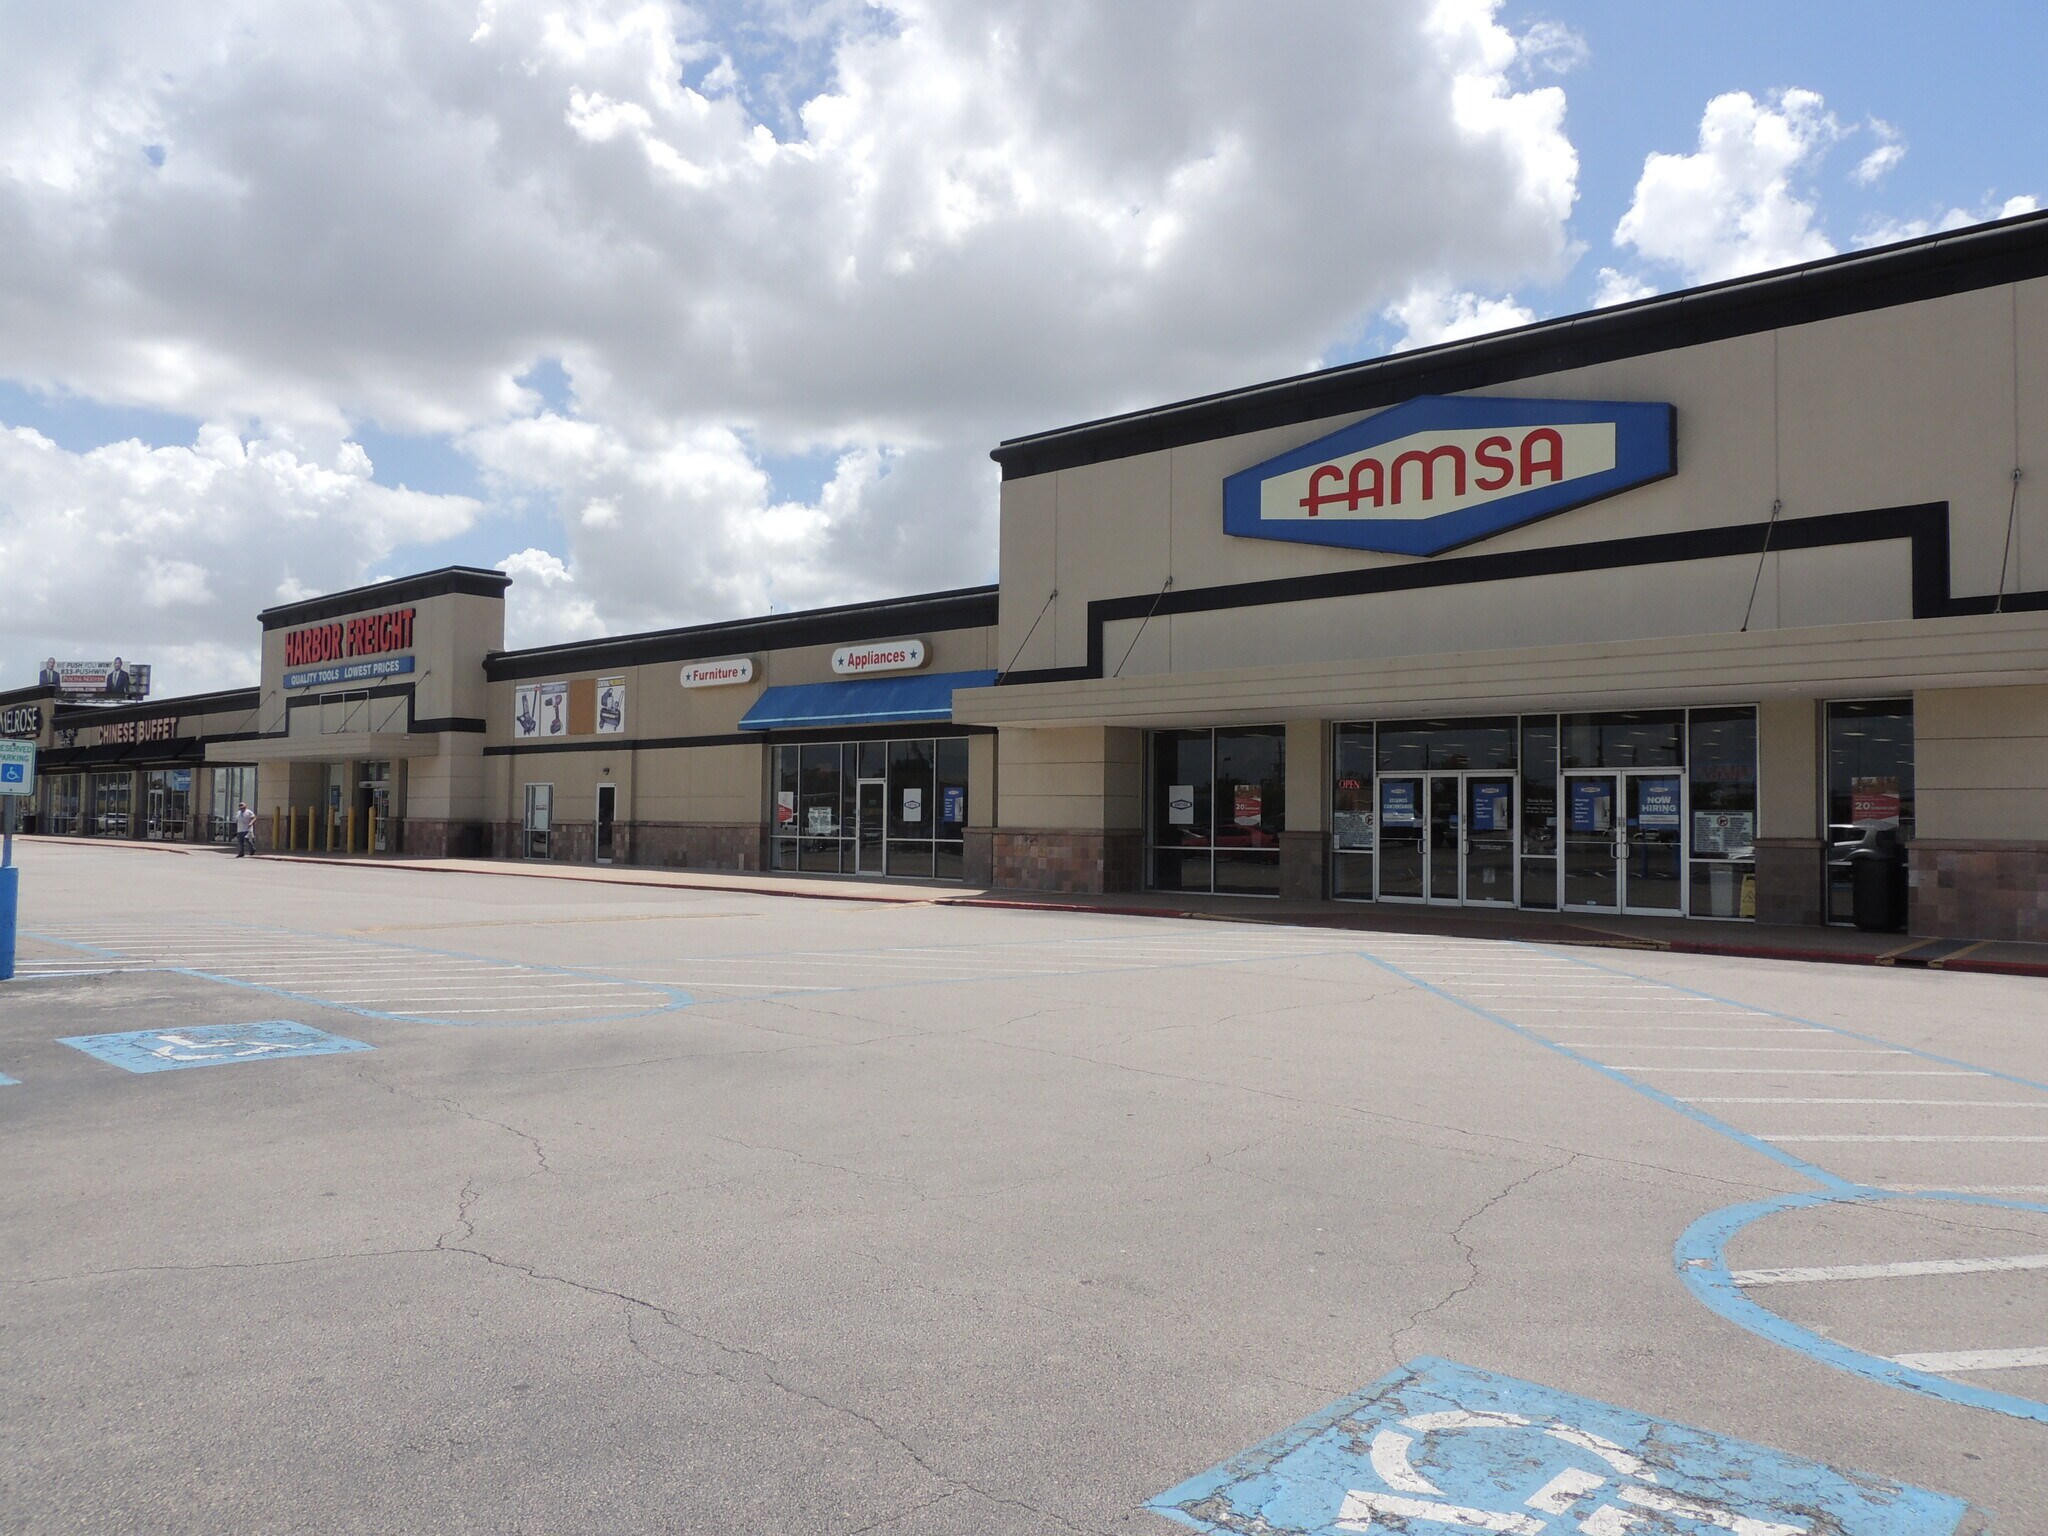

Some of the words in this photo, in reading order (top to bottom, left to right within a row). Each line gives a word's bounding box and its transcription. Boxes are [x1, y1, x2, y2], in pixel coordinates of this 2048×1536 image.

[1299, 428, 1563, 517] FAMSA
[285, 622, 343, 666] HARBOR
[346, 608, 416, 657] FREIGHT
[846, 649, 906, 671] Appliances
[291, 671, 317, 686] QUALITY
[318, 669, 339, 683] TOOLS
[344, 664, 372, 679] LOWEST
[373, 660, 400, 675] PRICES
[692, 667, 739, 681] Furniture
[98, 722, 135, 745] CHINESE
[138, 717, 177, 740] BUFFET
[0, 744, 32, 753] ESERVED
[1338, 779, 1360, 789] OPEN
[1641, 805, 1676, 813] HIRING
[1647, 796, 1671, 804] NOW
